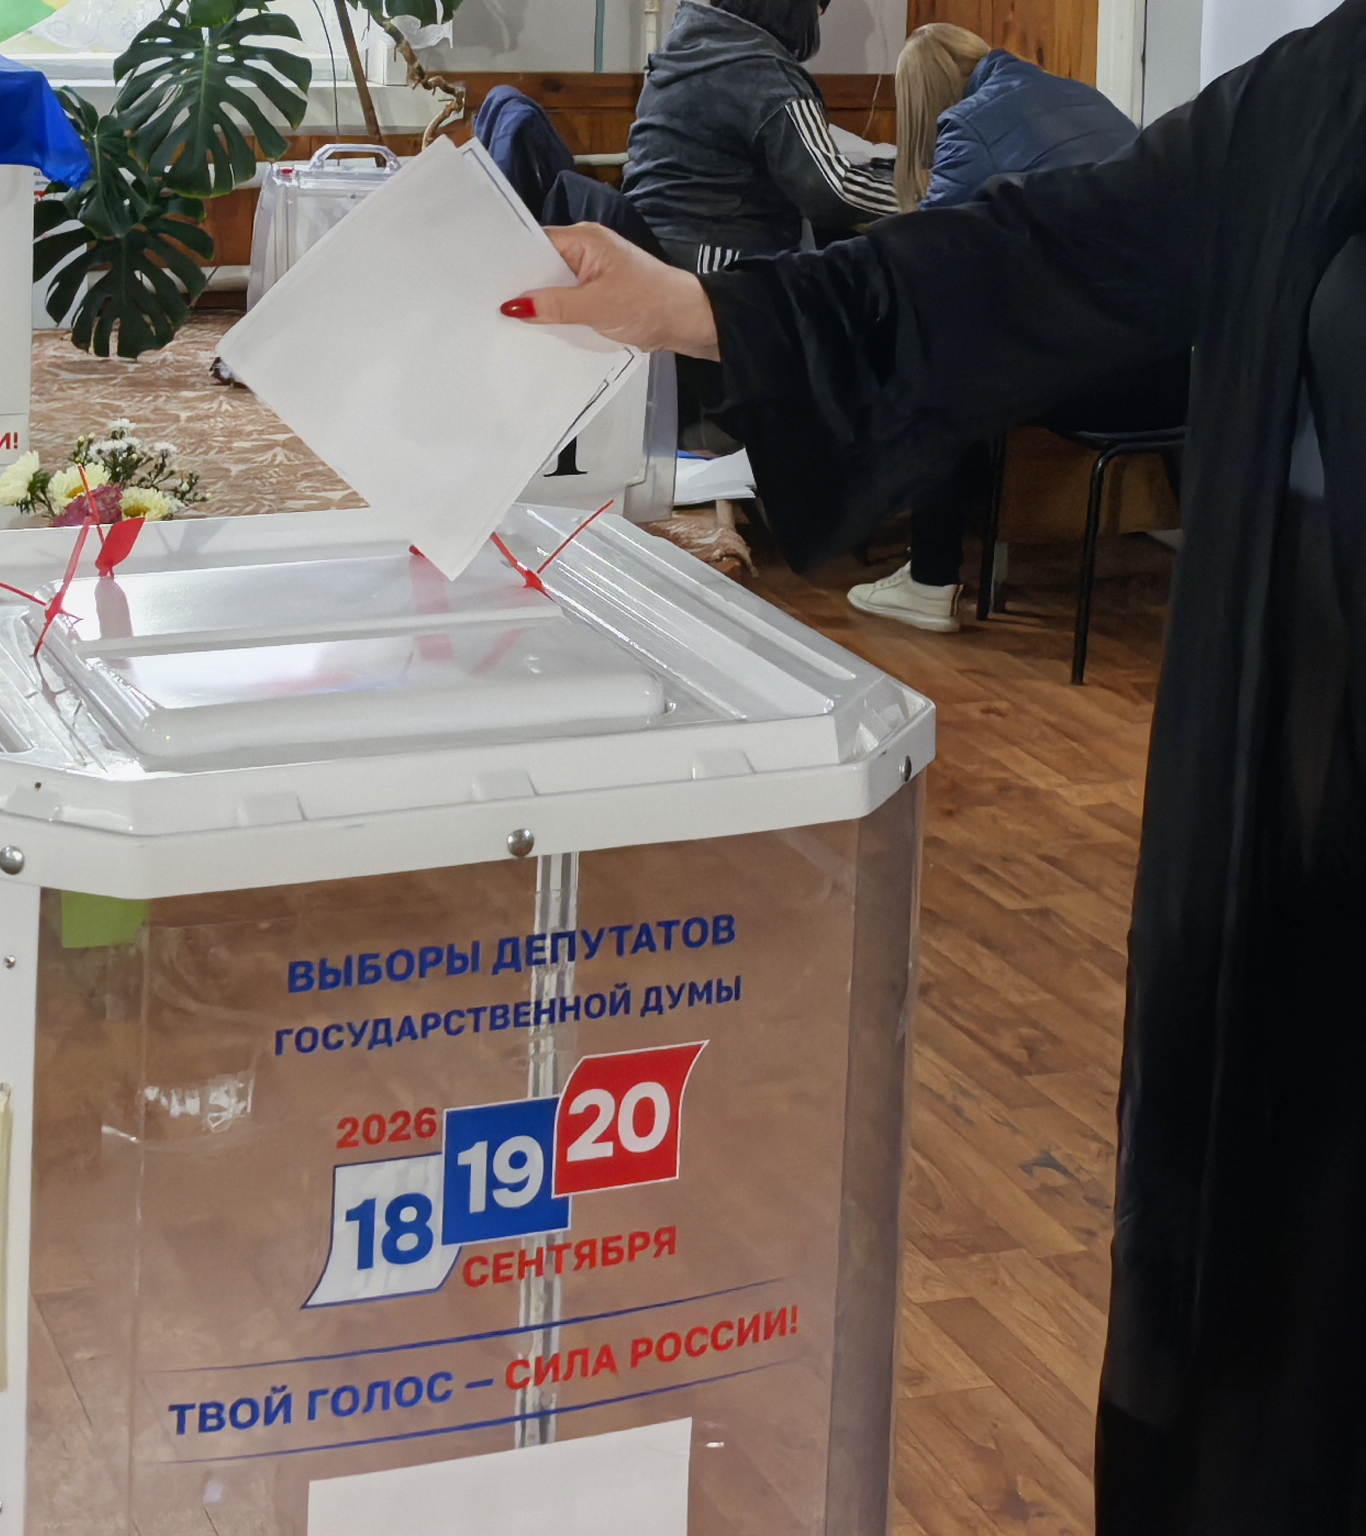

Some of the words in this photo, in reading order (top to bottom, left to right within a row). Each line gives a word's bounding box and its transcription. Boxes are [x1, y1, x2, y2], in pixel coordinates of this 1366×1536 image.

[286, 940, 481, 994] ВЫБОРЫ
[492, 914, 736, 975] ДЕПУТАТОВ
[274, 983, 631, 1055] ГОСУДАРСТВЕННОЙ
[640, 976, 742, 1017] ДУМЫ
[336, 1106, 437, 1149] 2026
[344, 1192, 434, 1270] 18
[456, 1134, 544, 1214] 19
[566, 1080, 671, 1161] 20
[462, 1225, 677, 1287] СЕНТЯБРЯ
[168, 1386, 292, 1435] ТВОЙ
[307, 1370, 453, 1421] ГОЛОС
[505, 1345, 617, 1391] СИЛА
[630, 1305, 799, 1367] РОССИИ!
